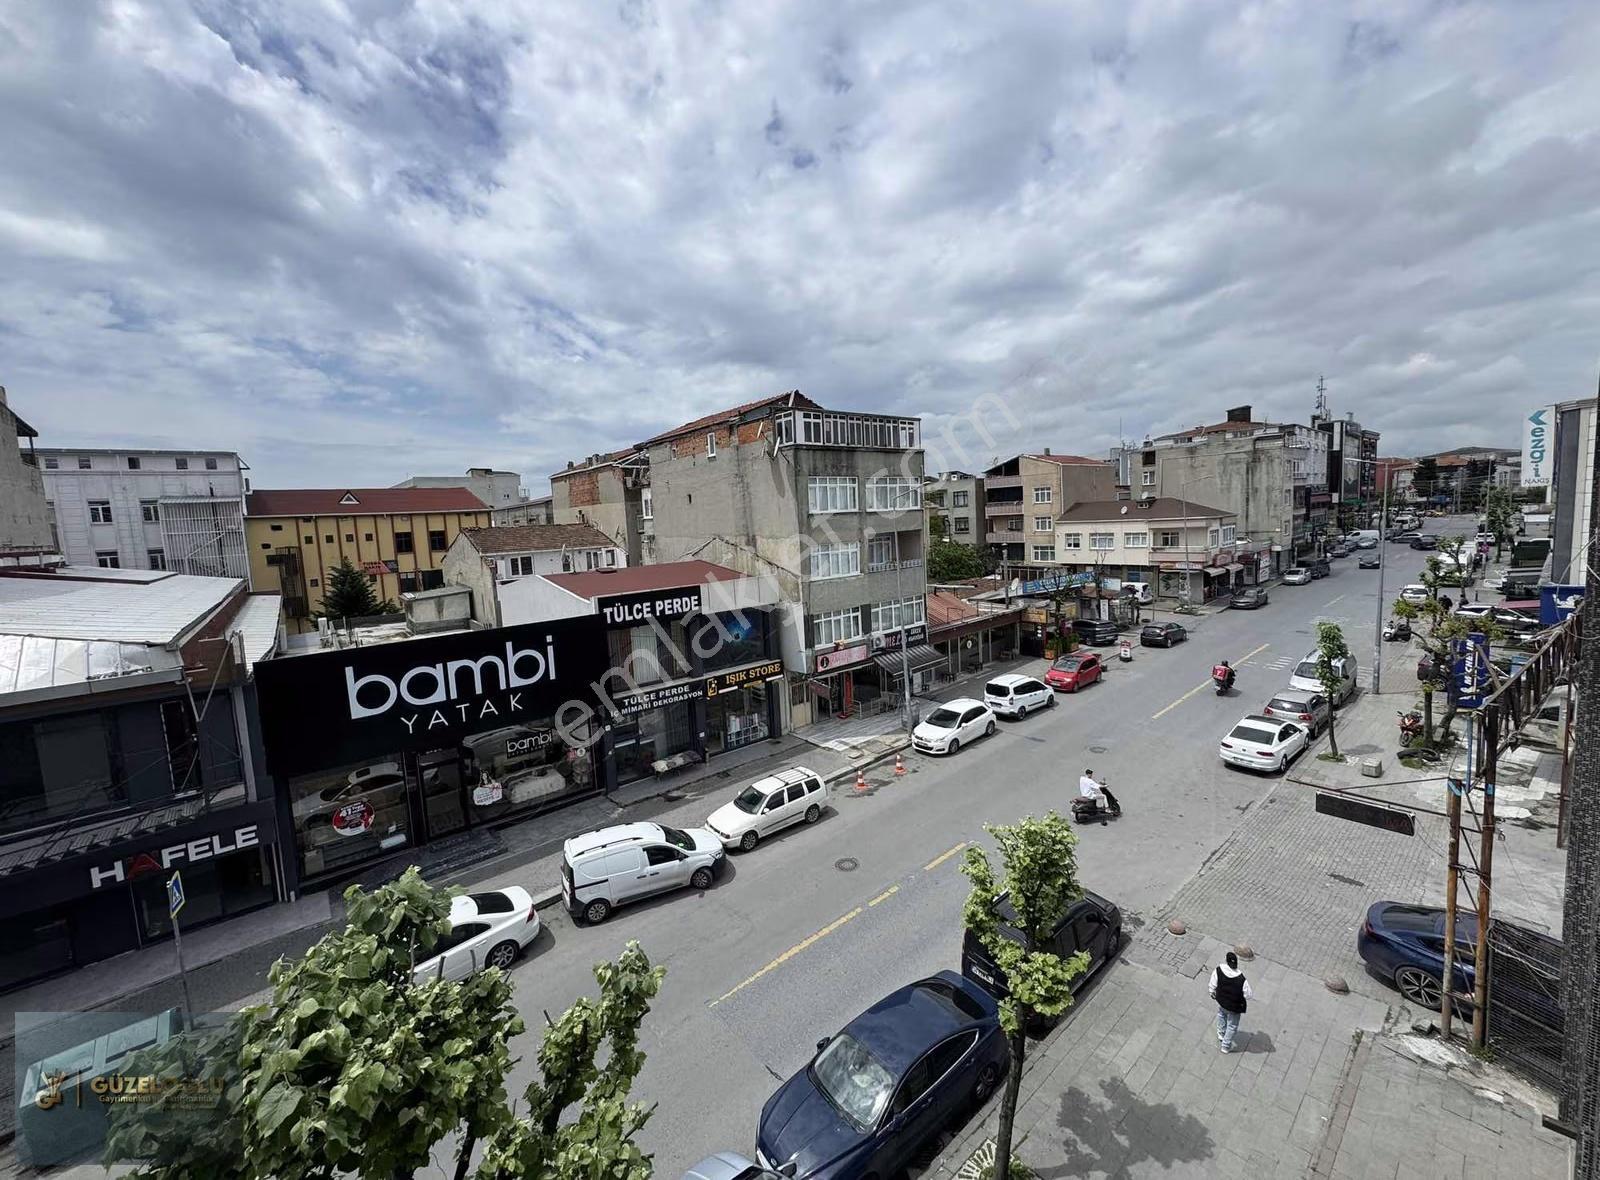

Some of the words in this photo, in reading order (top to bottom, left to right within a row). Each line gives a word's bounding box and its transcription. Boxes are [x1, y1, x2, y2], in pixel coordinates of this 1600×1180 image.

[603, 601, 652, 624] TÜLCE
[655, 595, 699, 616] PERDE
[725, 669, 747, 684] IŞIK
[749, 663, 781, 679] STORE
[1464, 639, 1474, 686] MCHEIN
[344, 635, 556, 720] bambi
[623, 690, 658, 706] TÜLCE
[659, 684, 690, 698] PERDE
[653, 689, 703, 708] DEKORASYON
[400, 692, 523, 734] YATAK
[506, 729, 553, 753] bambi
